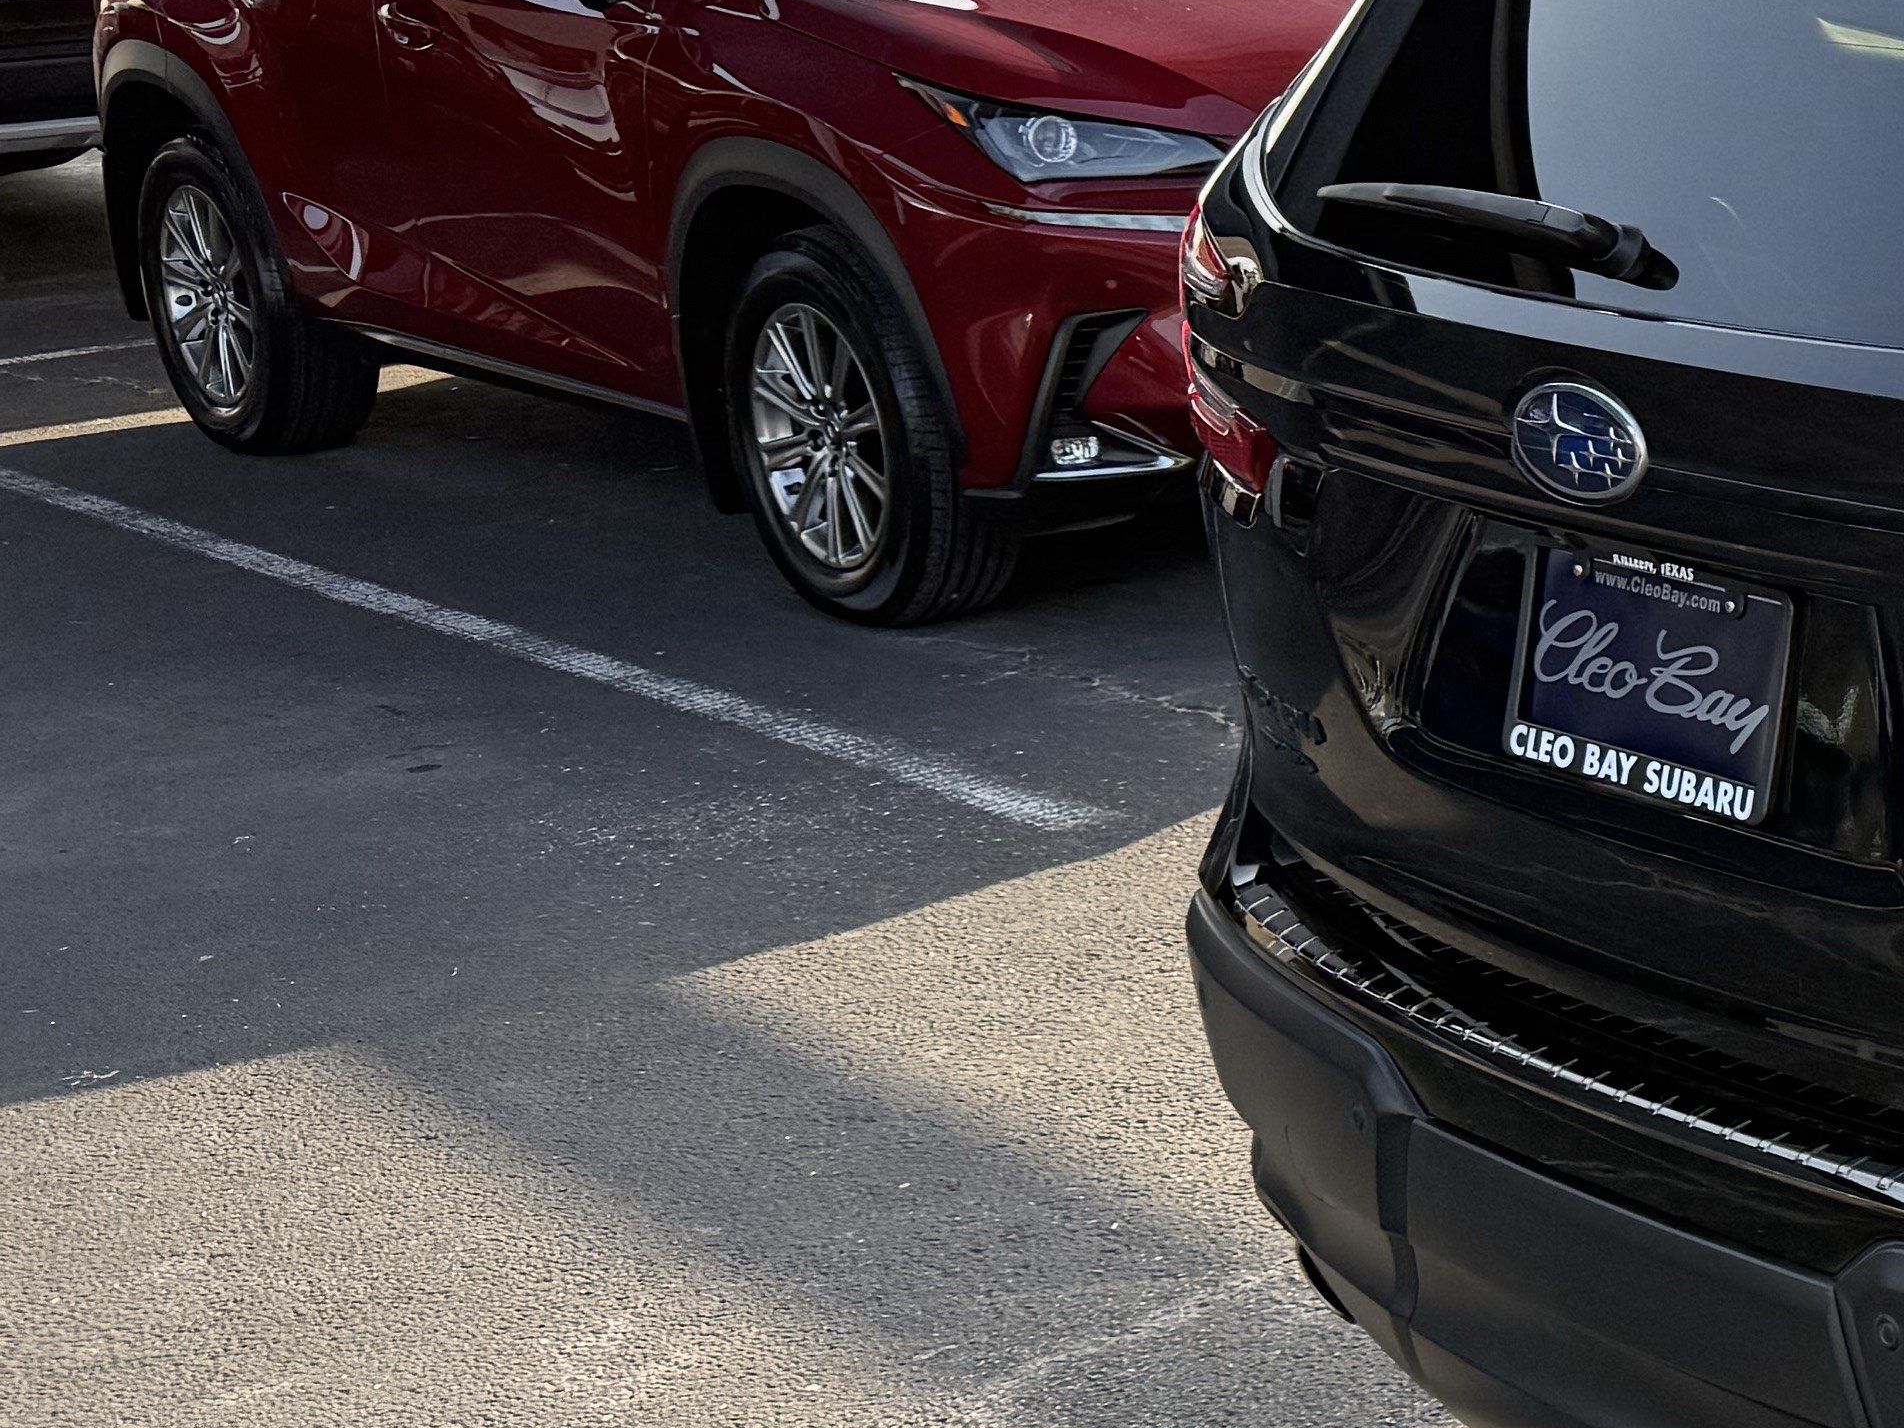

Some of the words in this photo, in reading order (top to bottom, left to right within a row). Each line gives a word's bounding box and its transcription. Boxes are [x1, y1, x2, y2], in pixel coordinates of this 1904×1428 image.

[1593, 568, 1721, 614] www.CleoBay.com
[1660, 561, 1695, 582] TEXAS
[1534, 599, 1648, 699] Cleo
[1645, 629, 1770, 755] Bay
[1509, 724, 1575, 769] CLEO
[1582, 742, 1639, 785] BAY
[1643, 760, 1755, 821] SUBARU
